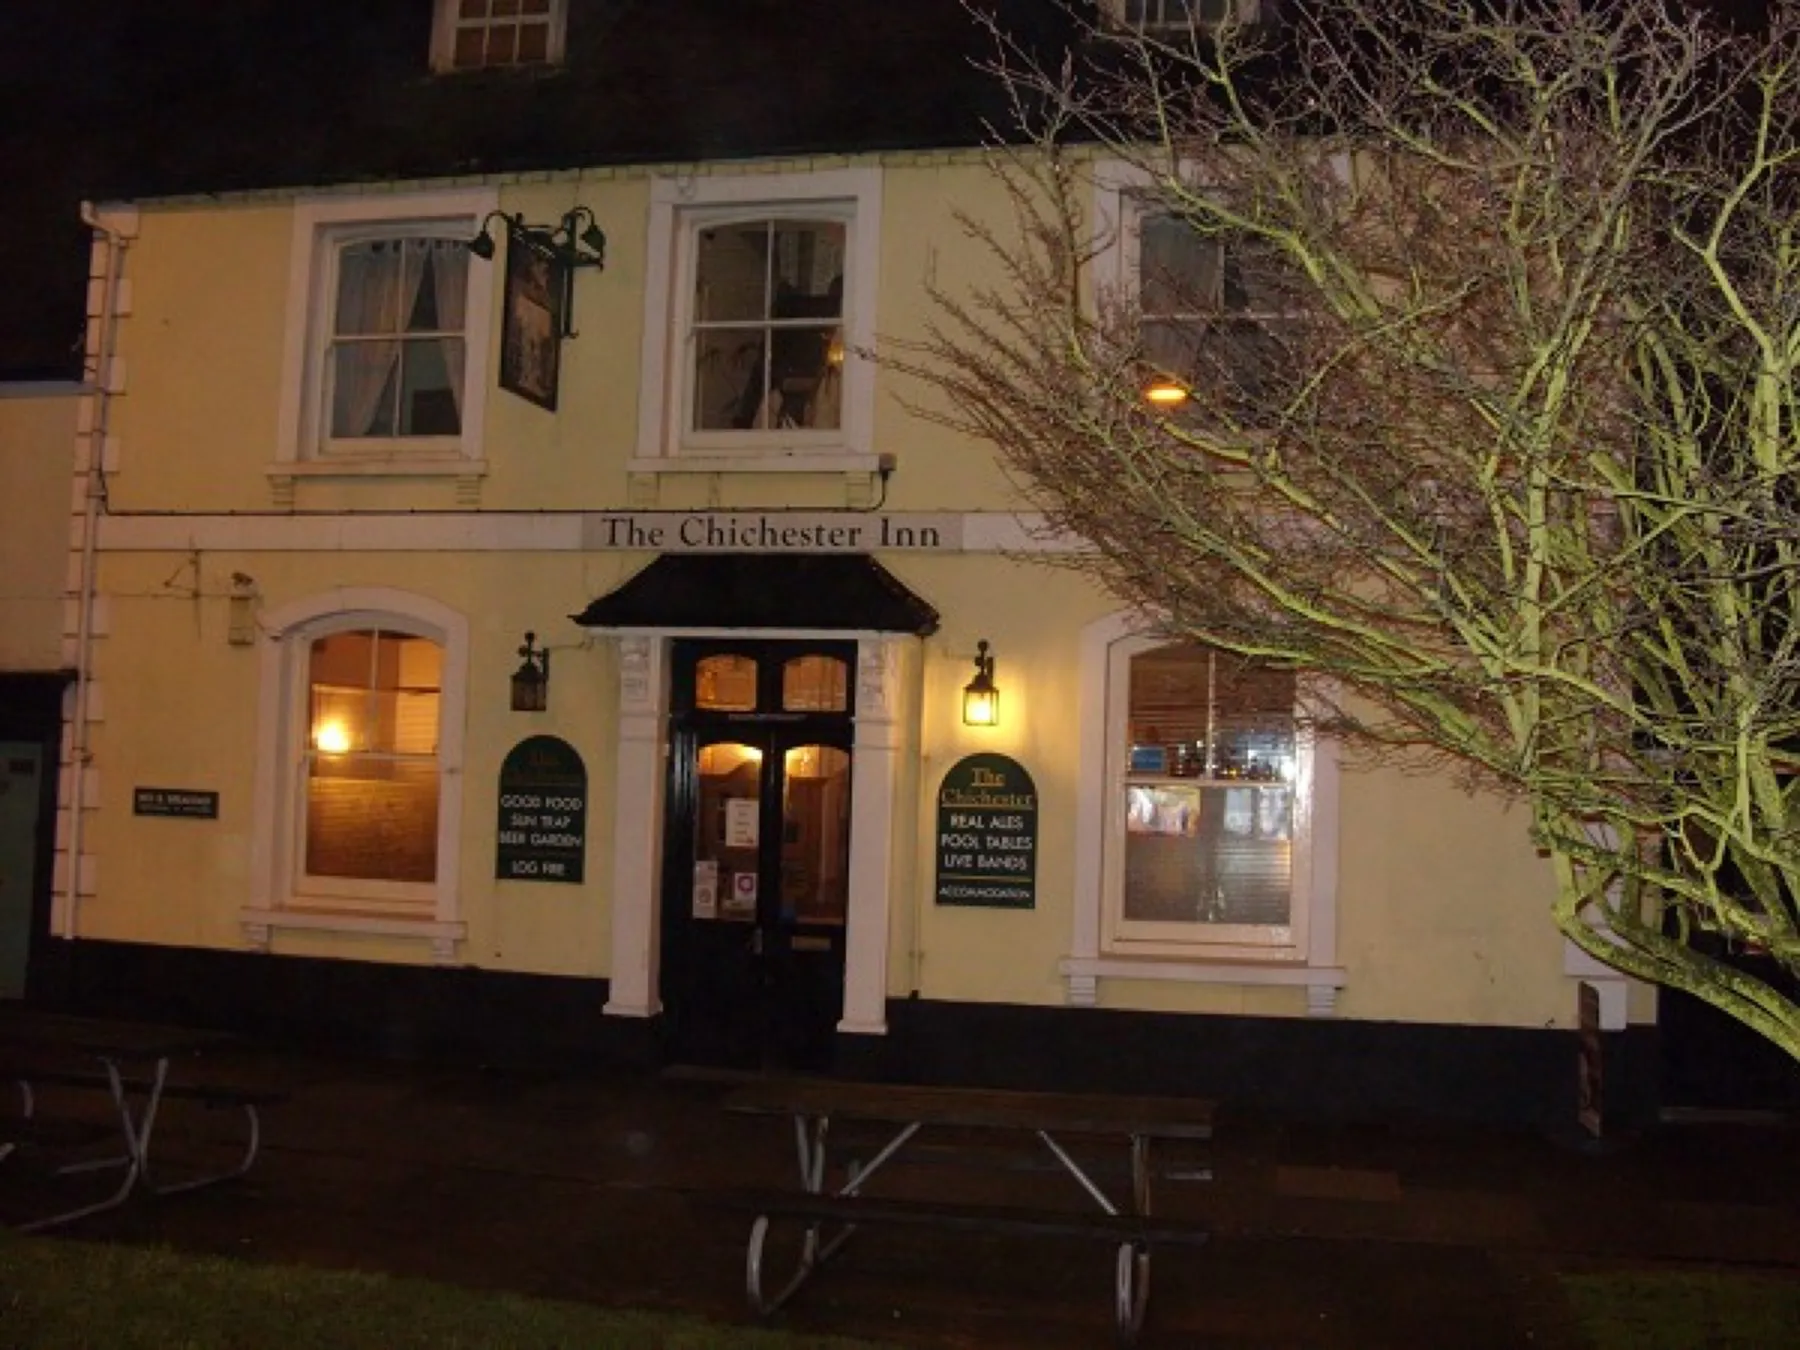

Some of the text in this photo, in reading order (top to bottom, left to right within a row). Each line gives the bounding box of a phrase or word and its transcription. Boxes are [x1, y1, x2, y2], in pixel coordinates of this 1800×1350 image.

[602, 516, 940, 547] The Chichester Inn
[972, 767, 1005, 786] The
[501, 794, 582, 811] GOOD FOOD
[950, 814, 1024, 830] REAL ALES
[530, 833, 582, 847] GARDEN
[941, 833, 1033, 851] POOL TABLES
[512, 860, 538, 875] LOG
[944, 854, 1027, 870] LIVE BANDS
